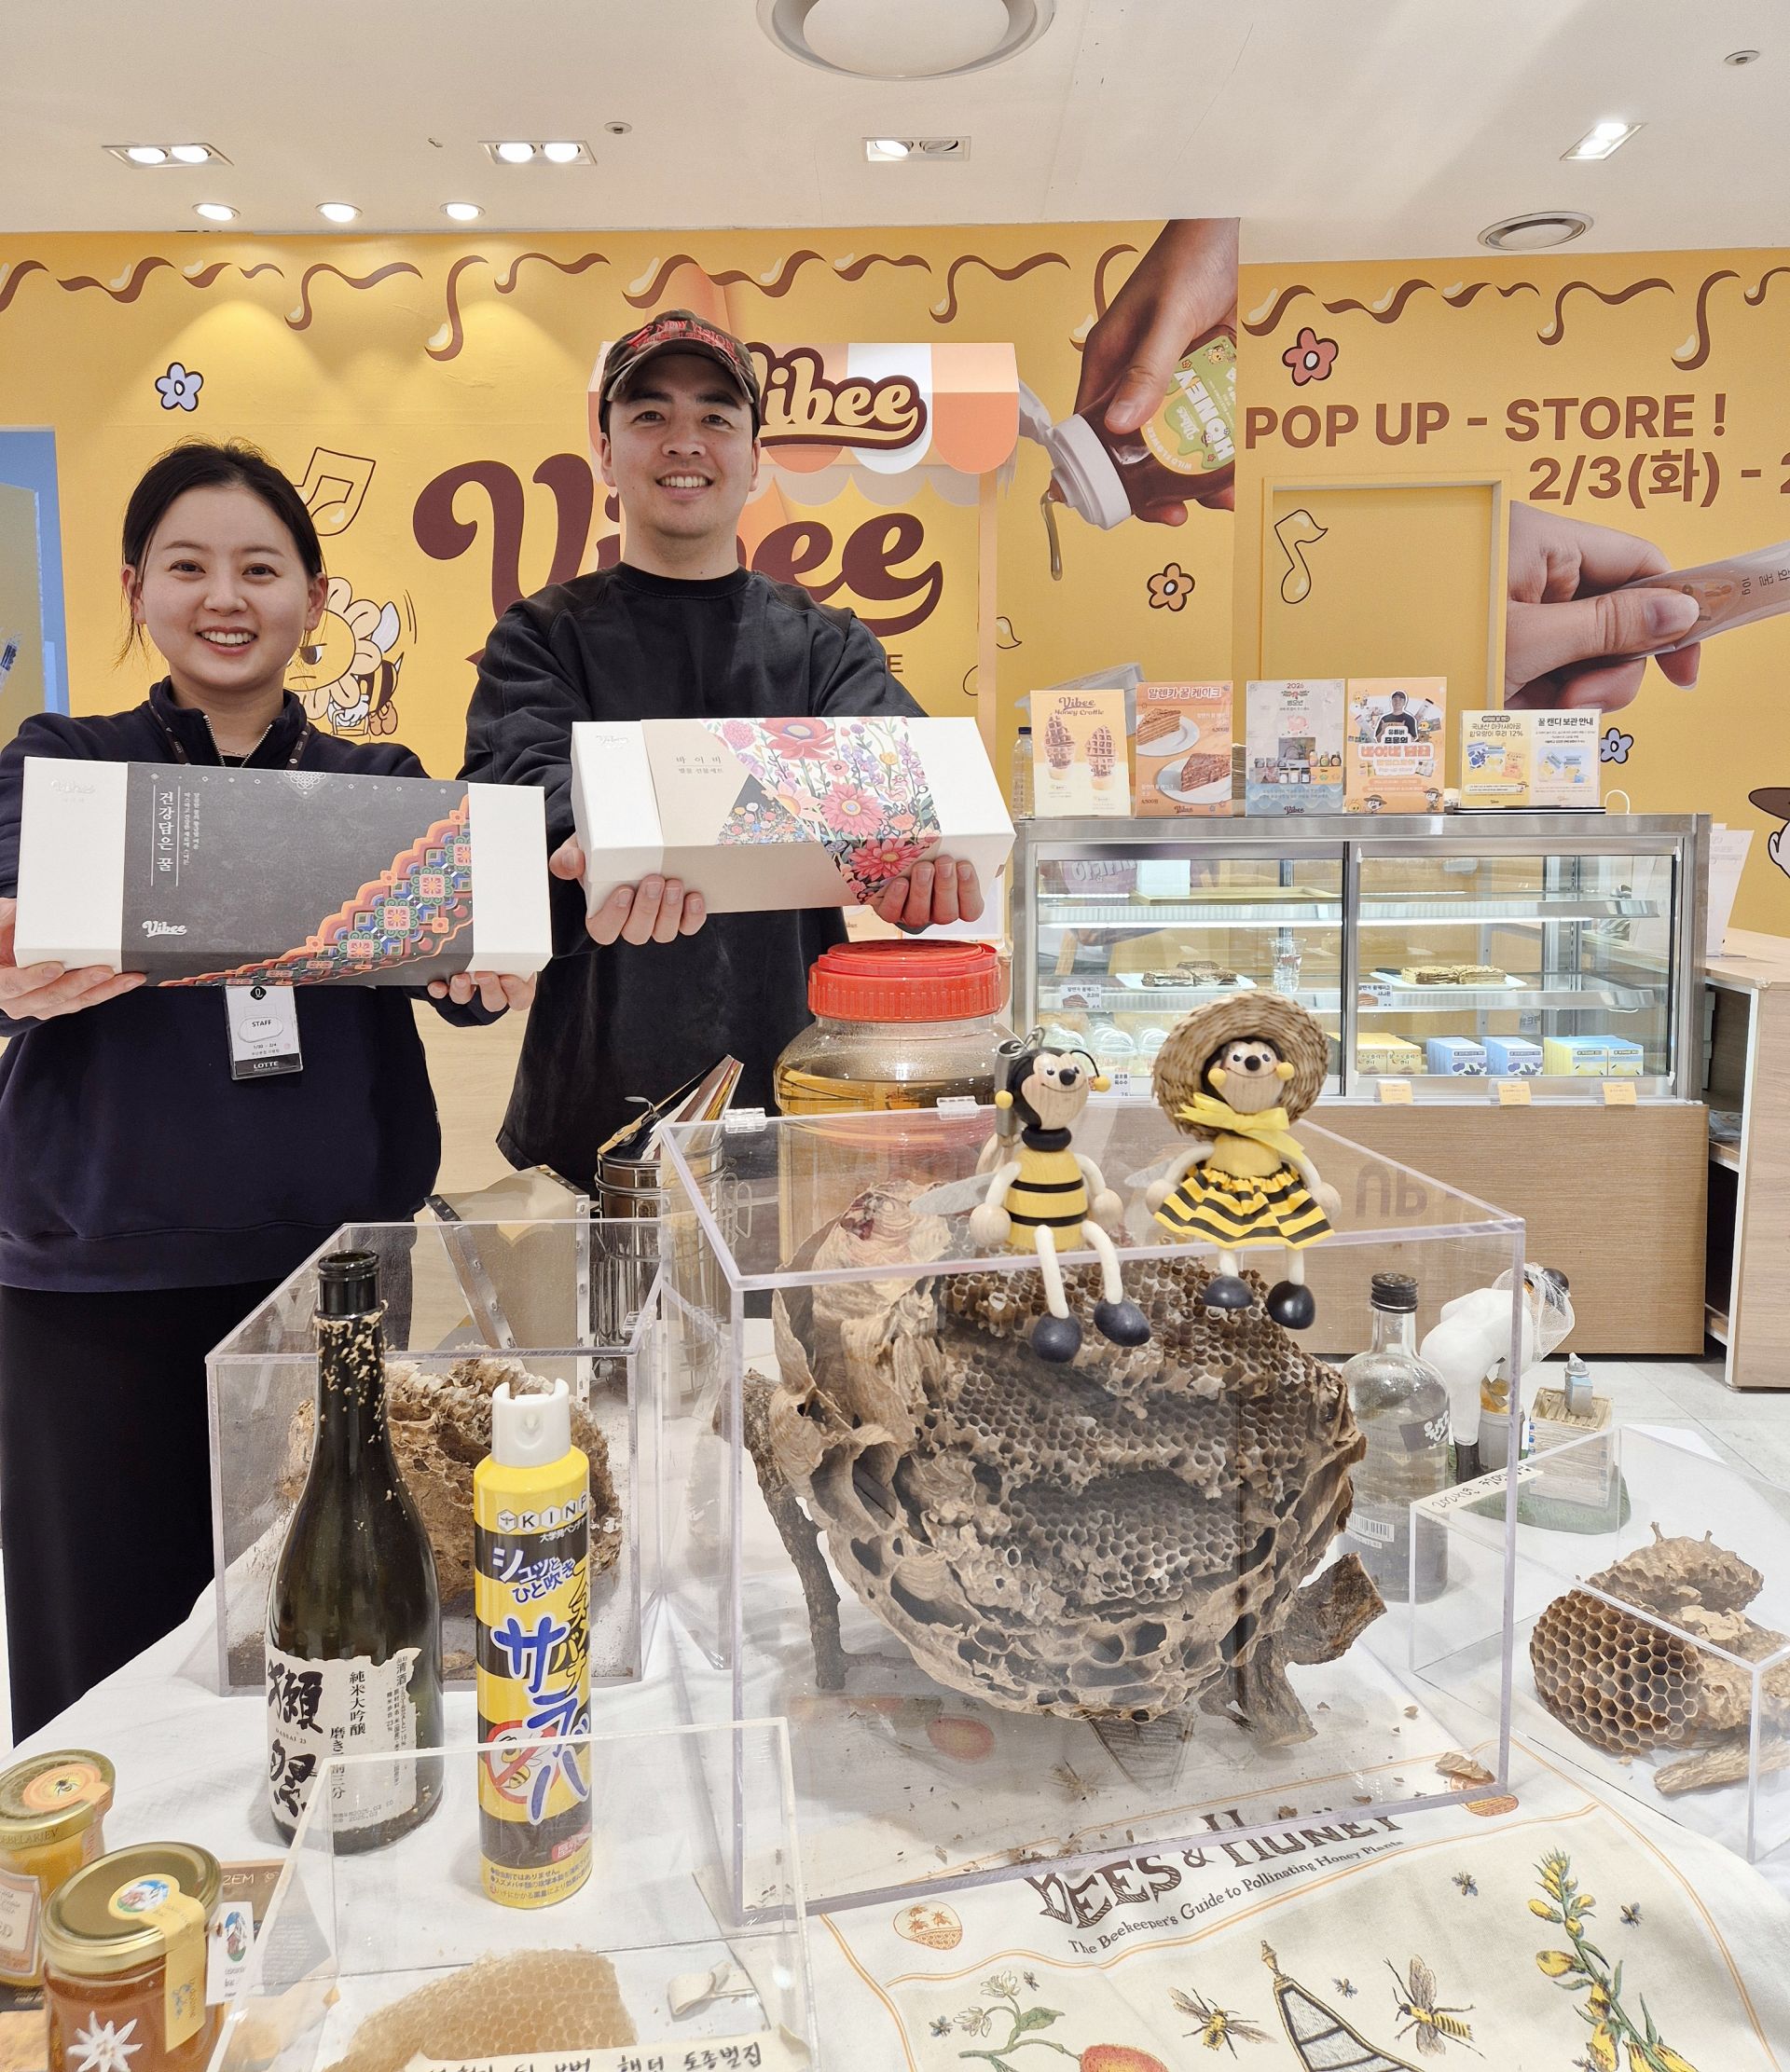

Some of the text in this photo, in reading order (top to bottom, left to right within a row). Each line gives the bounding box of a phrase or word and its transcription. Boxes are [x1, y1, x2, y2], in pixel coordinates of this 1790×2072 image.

[747, 342, 928, 450] ibee
[1173, 367, 1236, 462] HONEY
[1245, 404, 1359, 450] POP
[1375, 402, 1451, 446] UP
[1505, 393, 1696, 443] STORE
[1529, 447, 1721, 509] 2/3(화)
[1058, 696, 1096, 710] Vibee
[1191, 687, 1221, 699] 케이크
[1547, 717, 1562, 727] 캔디
[1563, 717, 1578, 726] 보관
[1578, 717, 1594, 726] 안내
[156, 791, 175, 872] 건강담은 꿀
[142, 920, 187, 939] Vibee
[252, 1019, 272, 1027] STAFF
[253, 1061, 280, 1069] LOTTE
[492, 1547, 561, 1585] シュッと
[512, 1558, 576, 1603] ひと吹き
[396, 1661, 407, 1687] 清酒
[349, 1669, 366, 1737] 純米大吟醸
[491, 1614, 591, 1823] サラバ
[275, 1727, 297, 1743] DASSAI
[1068, 1839, 1405, 1955] The Beekeeper's Guide to Pollinating Honey Plants
[683, 2041, 762, 2071] 토종벌집
